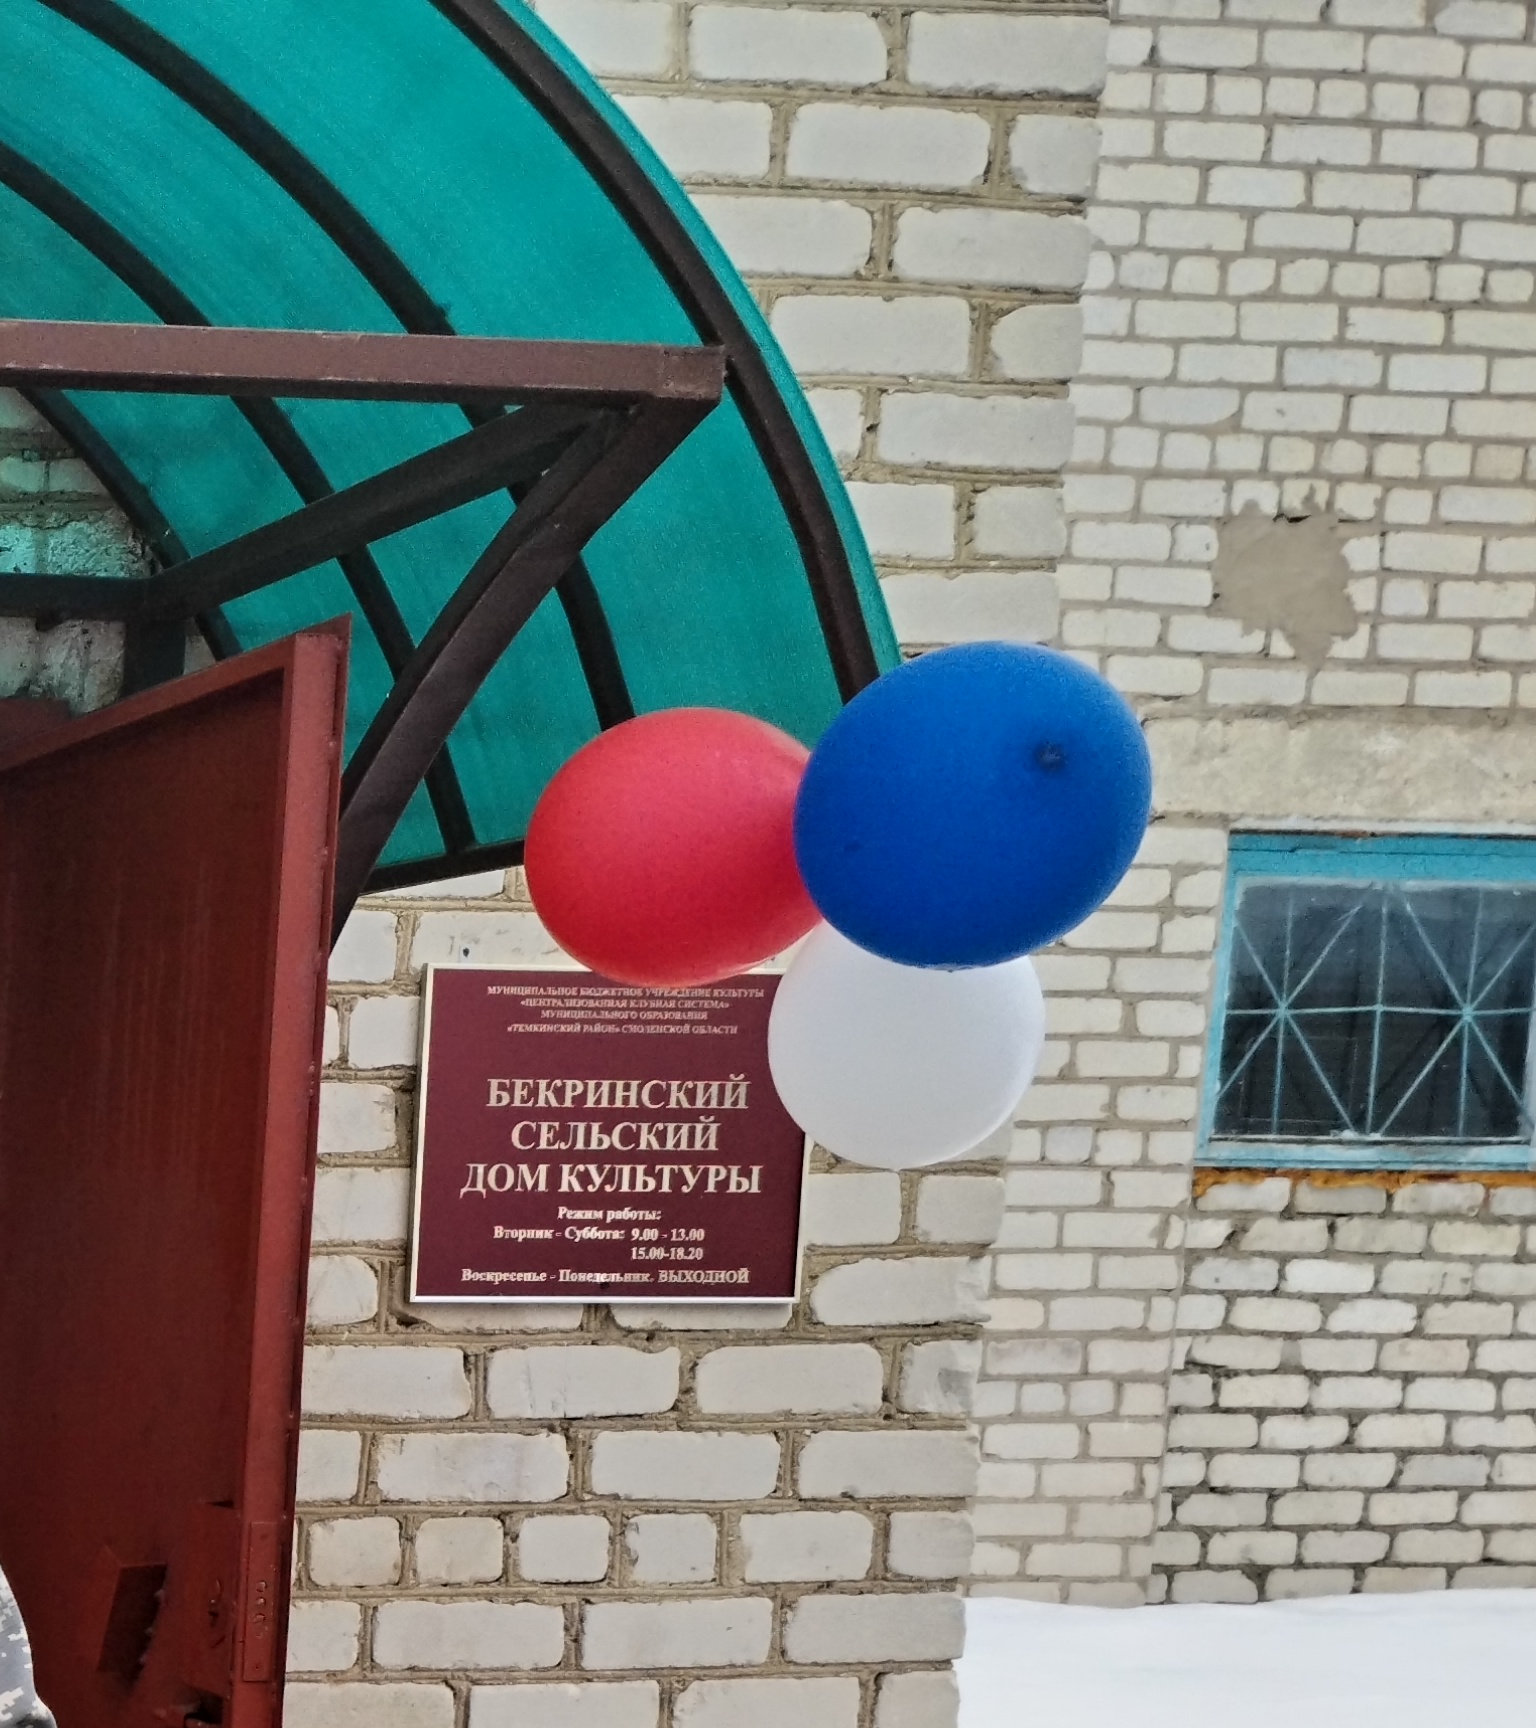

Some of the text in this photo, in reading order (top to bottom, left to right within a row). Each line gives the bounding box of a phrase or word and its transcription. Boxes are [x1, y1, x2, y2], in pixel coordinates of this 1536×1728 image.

[485, 1073, 752, 1110] БЕКРИНСКИЙ
[510, 1115, 722, 1151] СЕЛЬСКИЙ
[459, 1163, 764, 1199] ДОМ КУЛЬТУРЫ
[557, 1206, 662, 1223] Режим работы:
[493, 1226, 553, 1242] Вторник
[564, 1226, 626, 1243] Суббота:
[630, 1227, 659, 1242] 9.00
[670, 1228, 706, 1243] 13.00
[630, 1246, 704, 1261] 15.00-18.20
[461, 1268, 547, 1285] Воскресенье
[657, 1267, 750, 1286] ВЫХОДНОЙ
